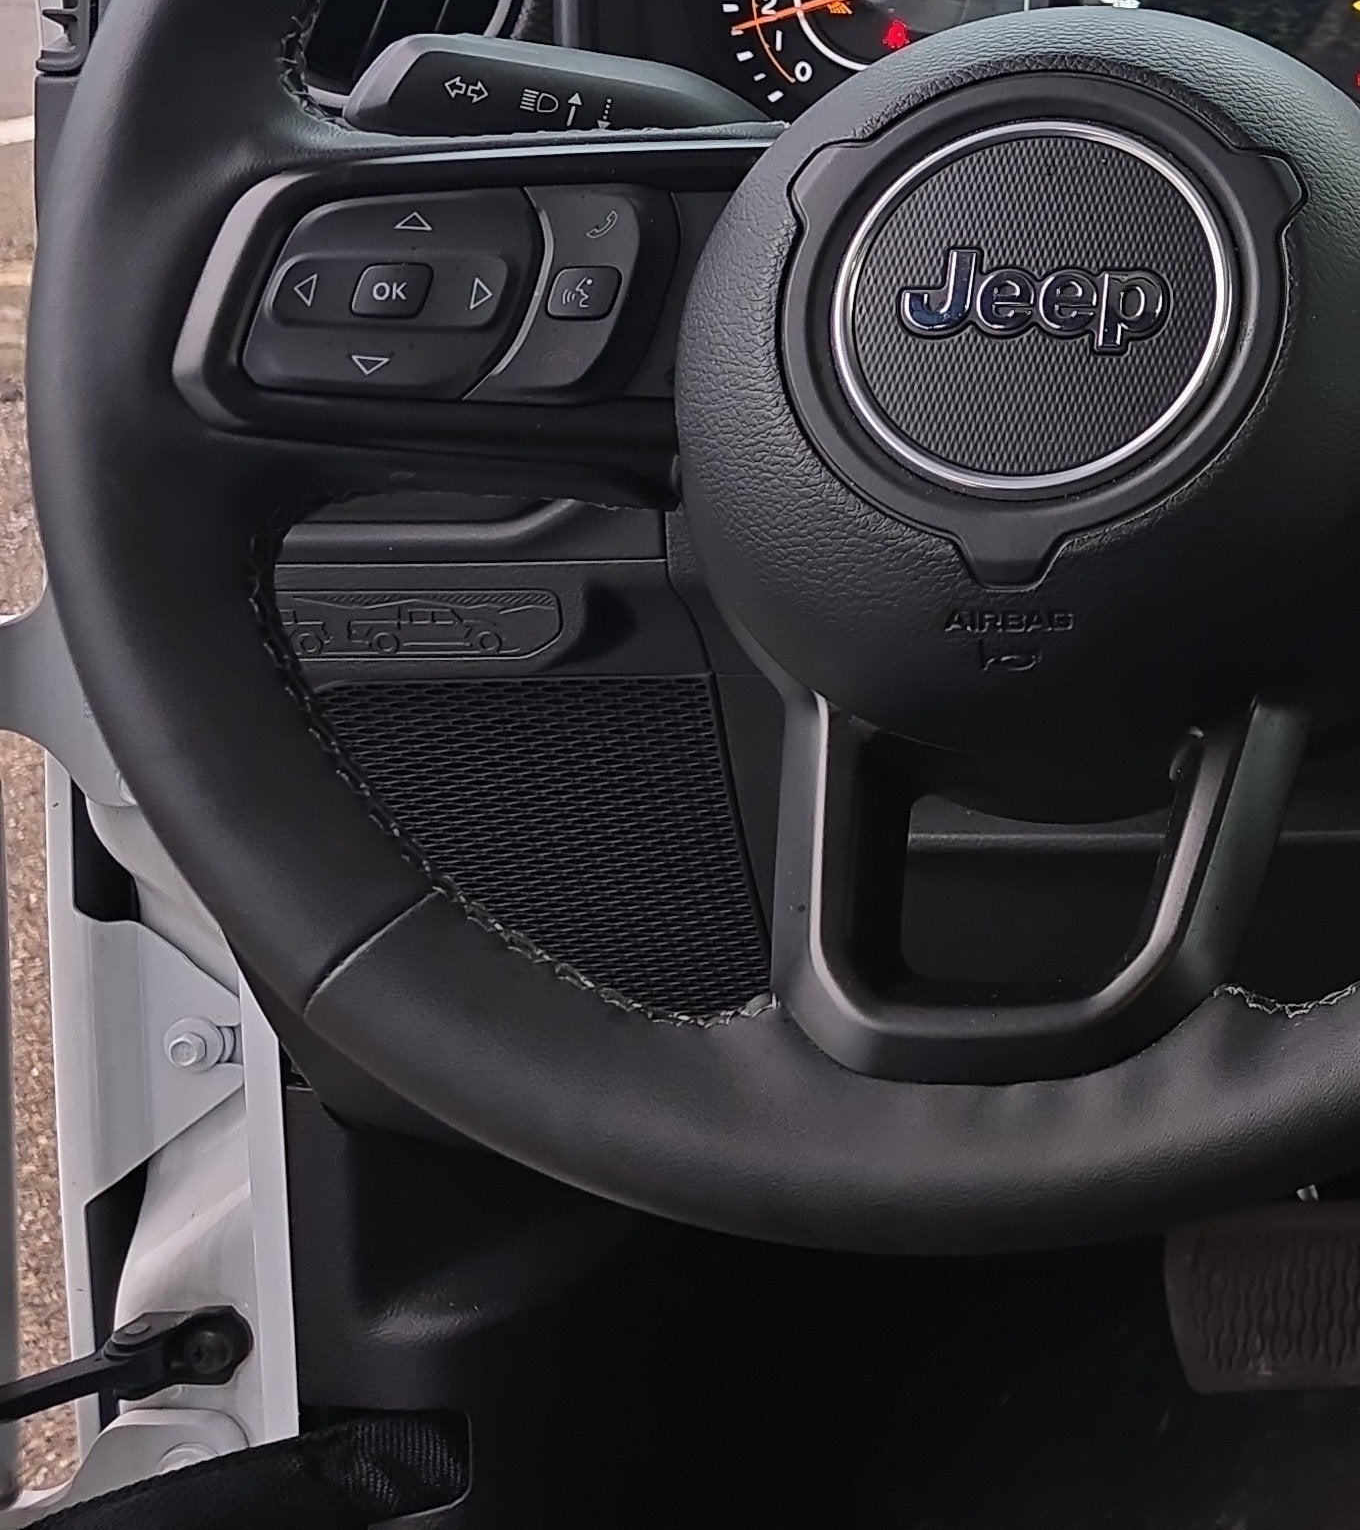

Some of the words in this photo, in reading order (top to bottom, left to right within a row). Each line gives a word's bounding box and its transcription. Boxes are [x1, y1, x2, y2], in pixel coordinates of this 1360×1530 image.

[775, 29, 783, 52] 1
[794, 60, 813, 83] 0
[371, 281, 408, 303] OK
[902, 248, 1170, 350] Jeep
[943, 611, 1075, 634] AIRBAG
